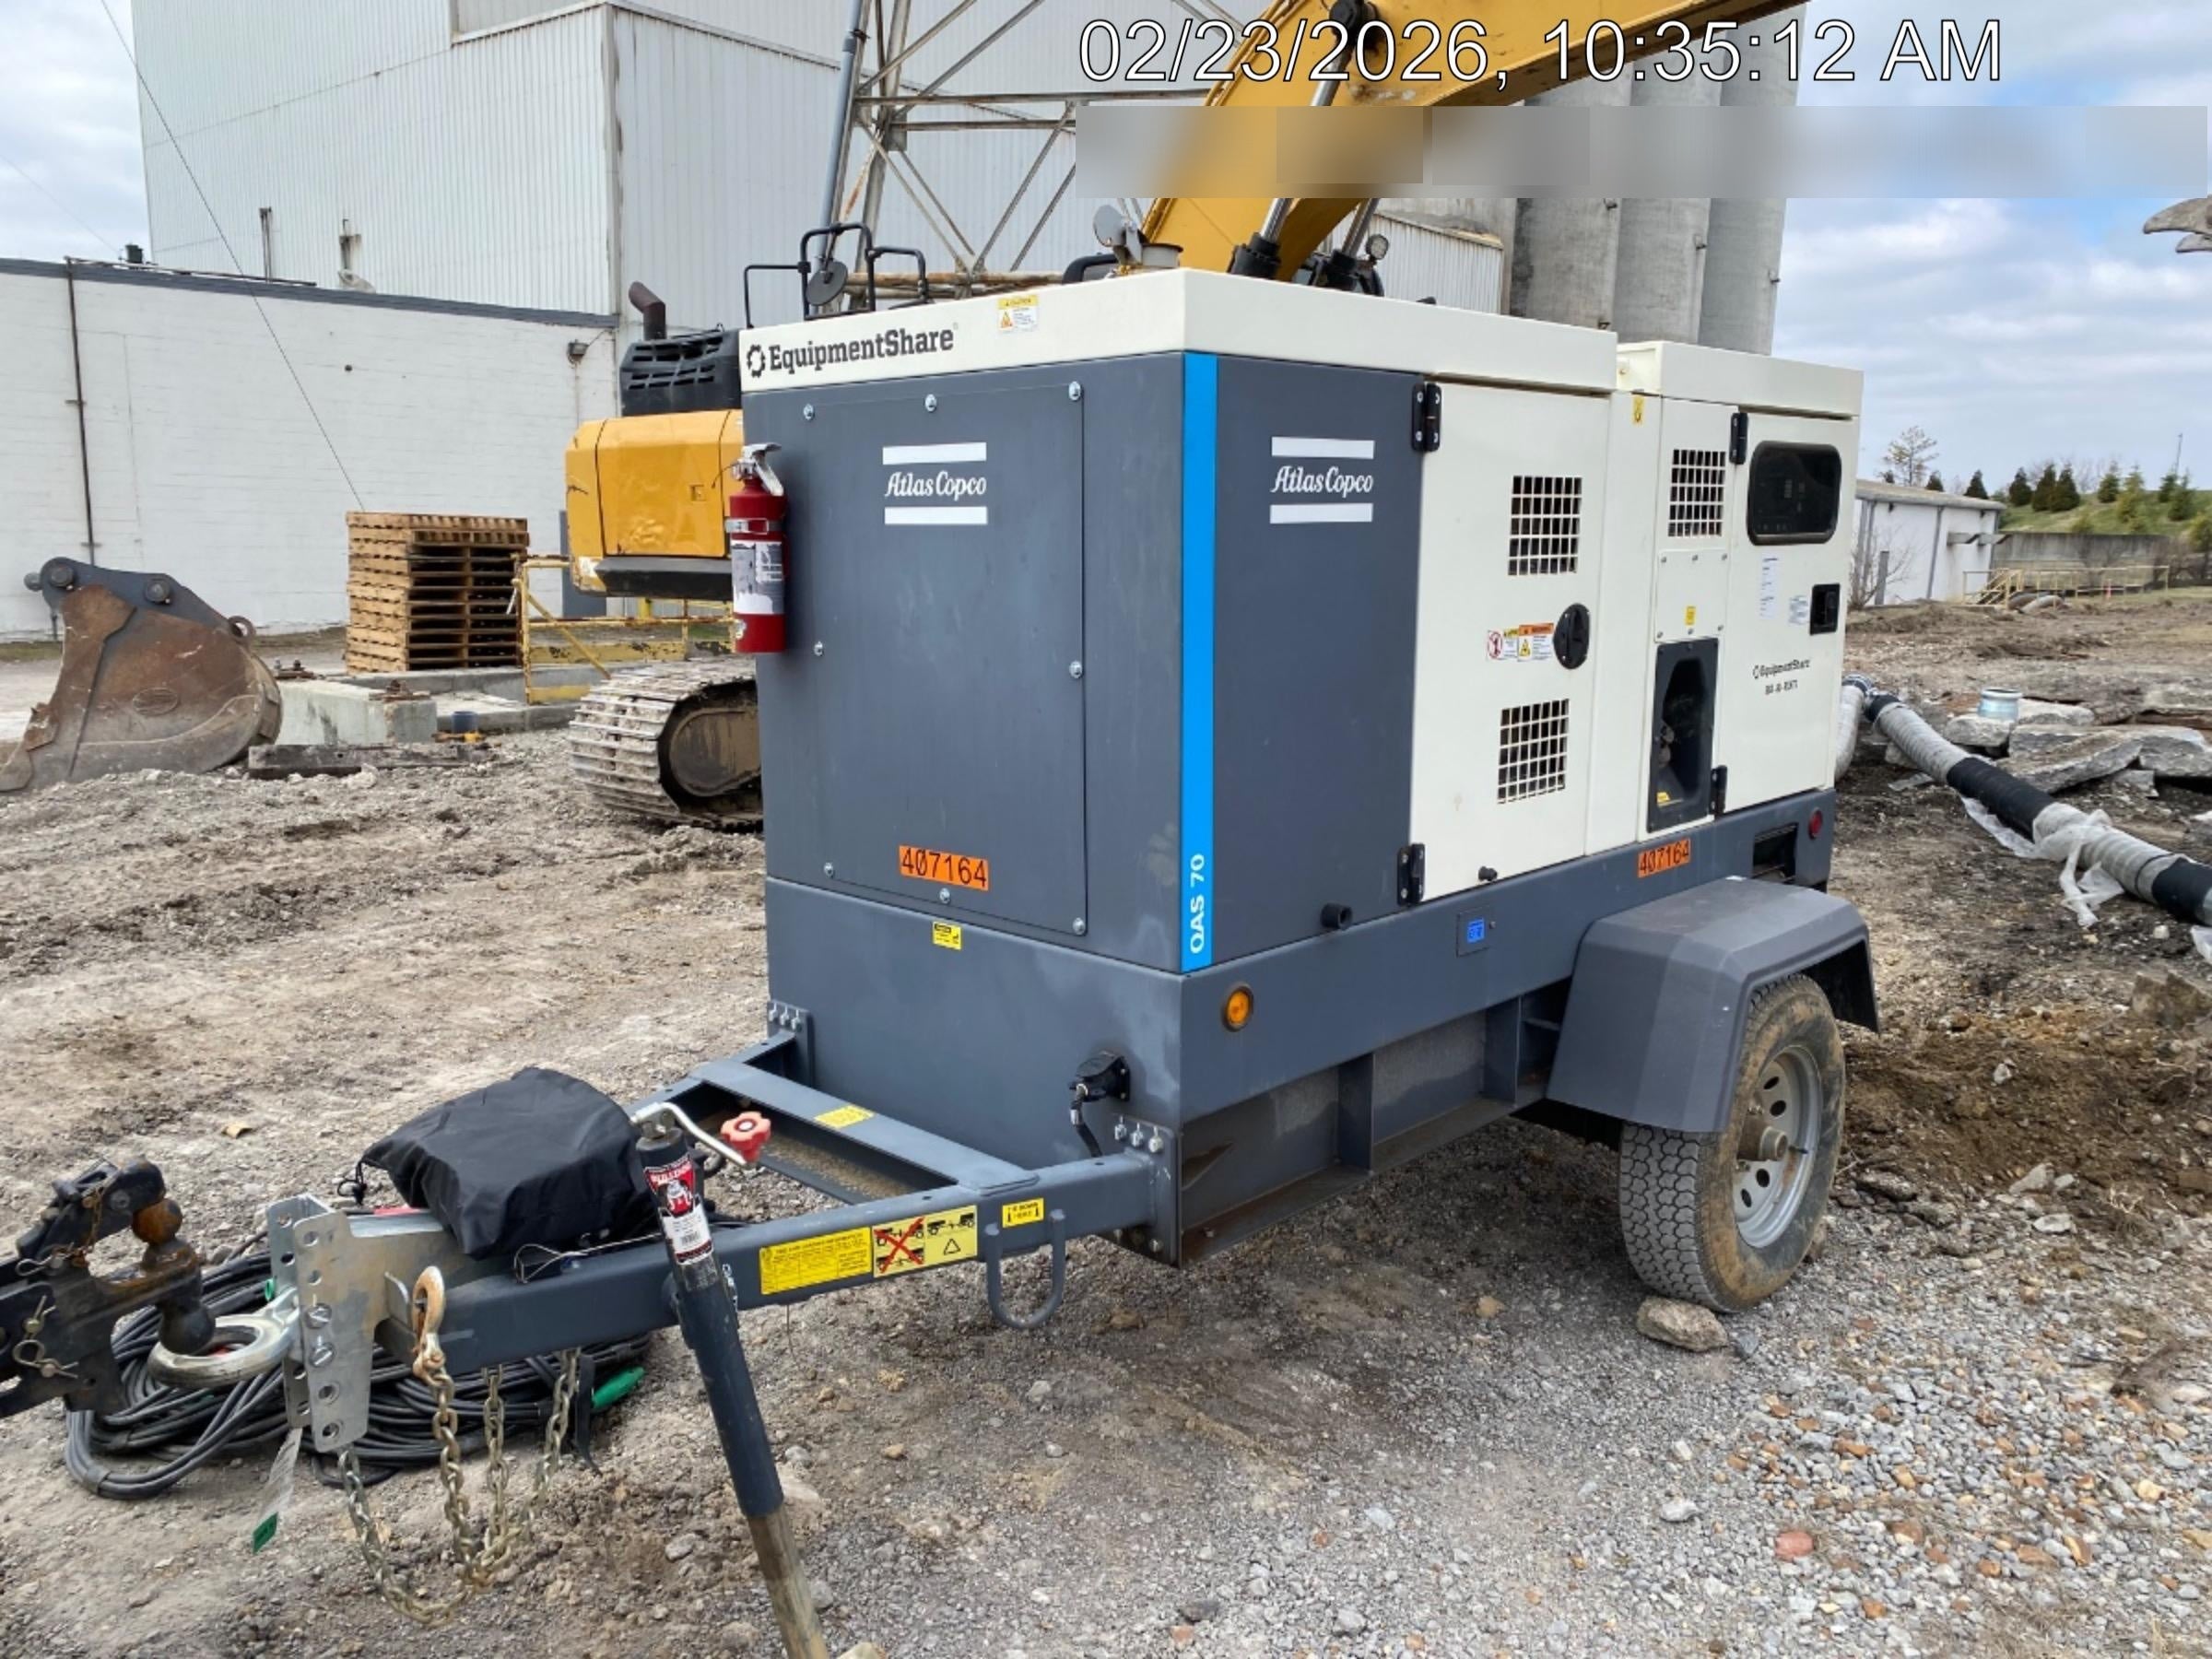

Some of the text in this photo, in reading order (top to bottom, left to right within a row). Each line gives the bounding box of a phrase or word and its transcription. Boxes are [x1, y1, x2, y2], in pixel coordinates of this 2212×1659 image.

[769, 327, 955, 374] EquipmentShare
[884, 470, 987, 501] Atlas Copco
[1270, 465, 1374, 499] Atlas Copco
[902, 847, 987, 888] 407164
[1640, 840, 1689, 874] 407164
[1190, 853, 1205, 954] QAS 70
